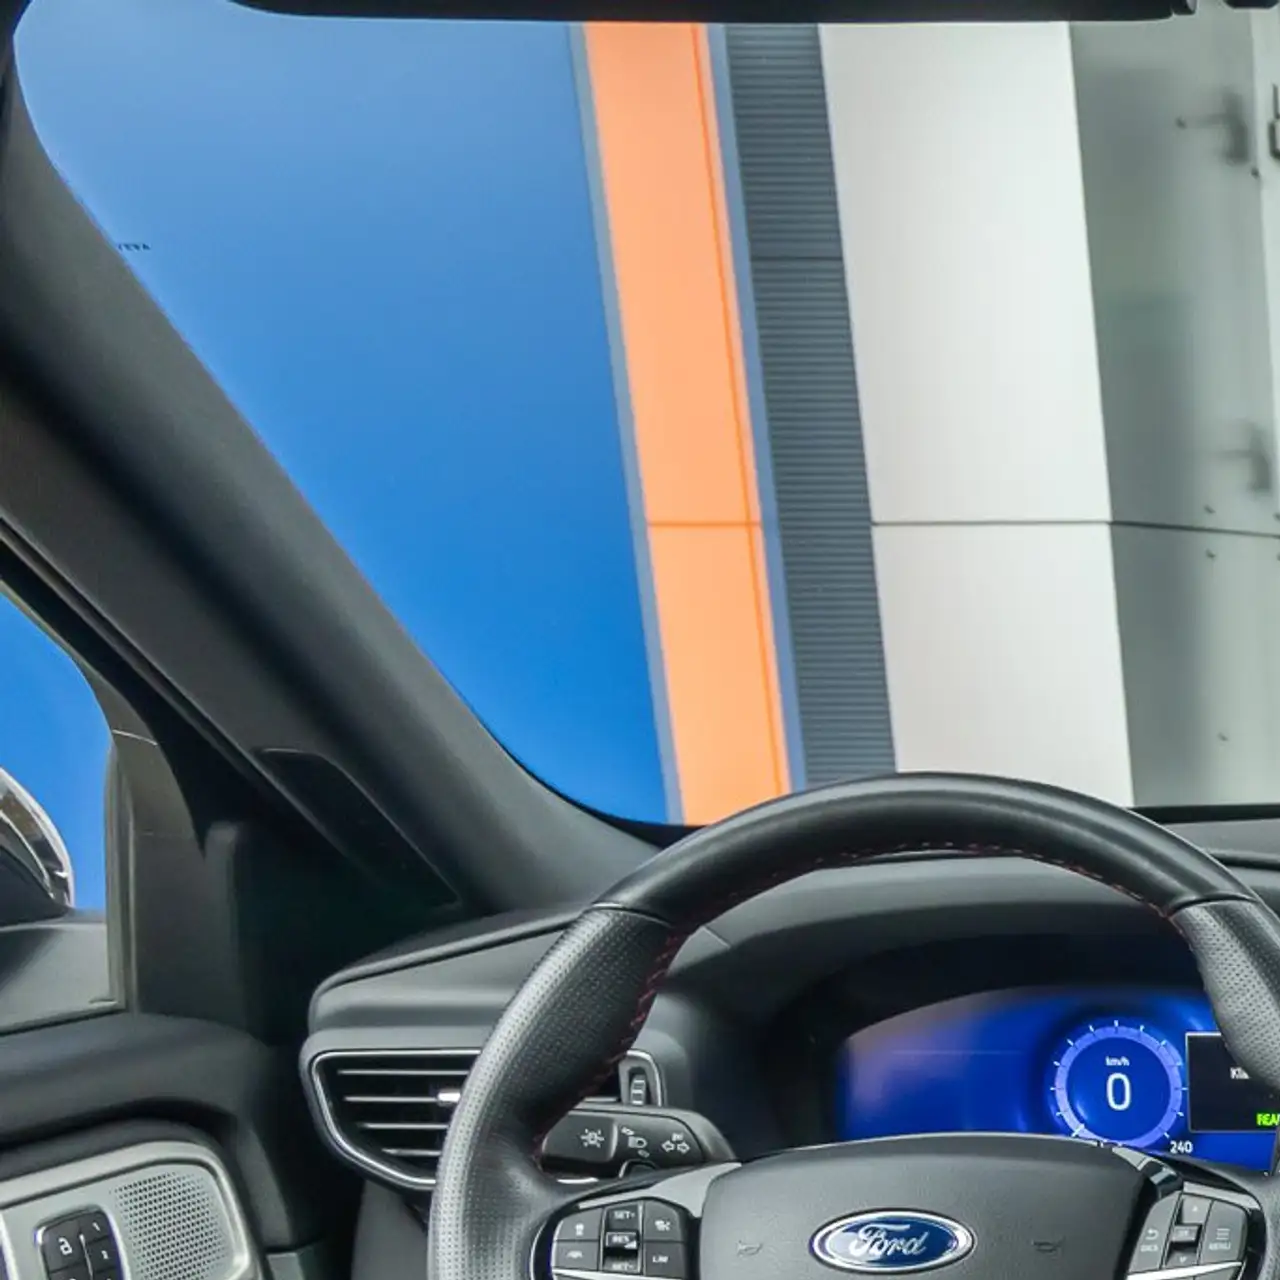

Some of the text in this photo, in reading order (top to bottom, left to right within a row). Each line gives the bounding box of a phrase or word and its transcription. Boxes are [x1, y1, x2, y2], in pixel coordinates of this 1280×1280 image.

[1106, 1072, 1131, 1111] 0
[1169, 1140, 1194, 1154] 240
[848, 1222, 929, 1257] Ford
